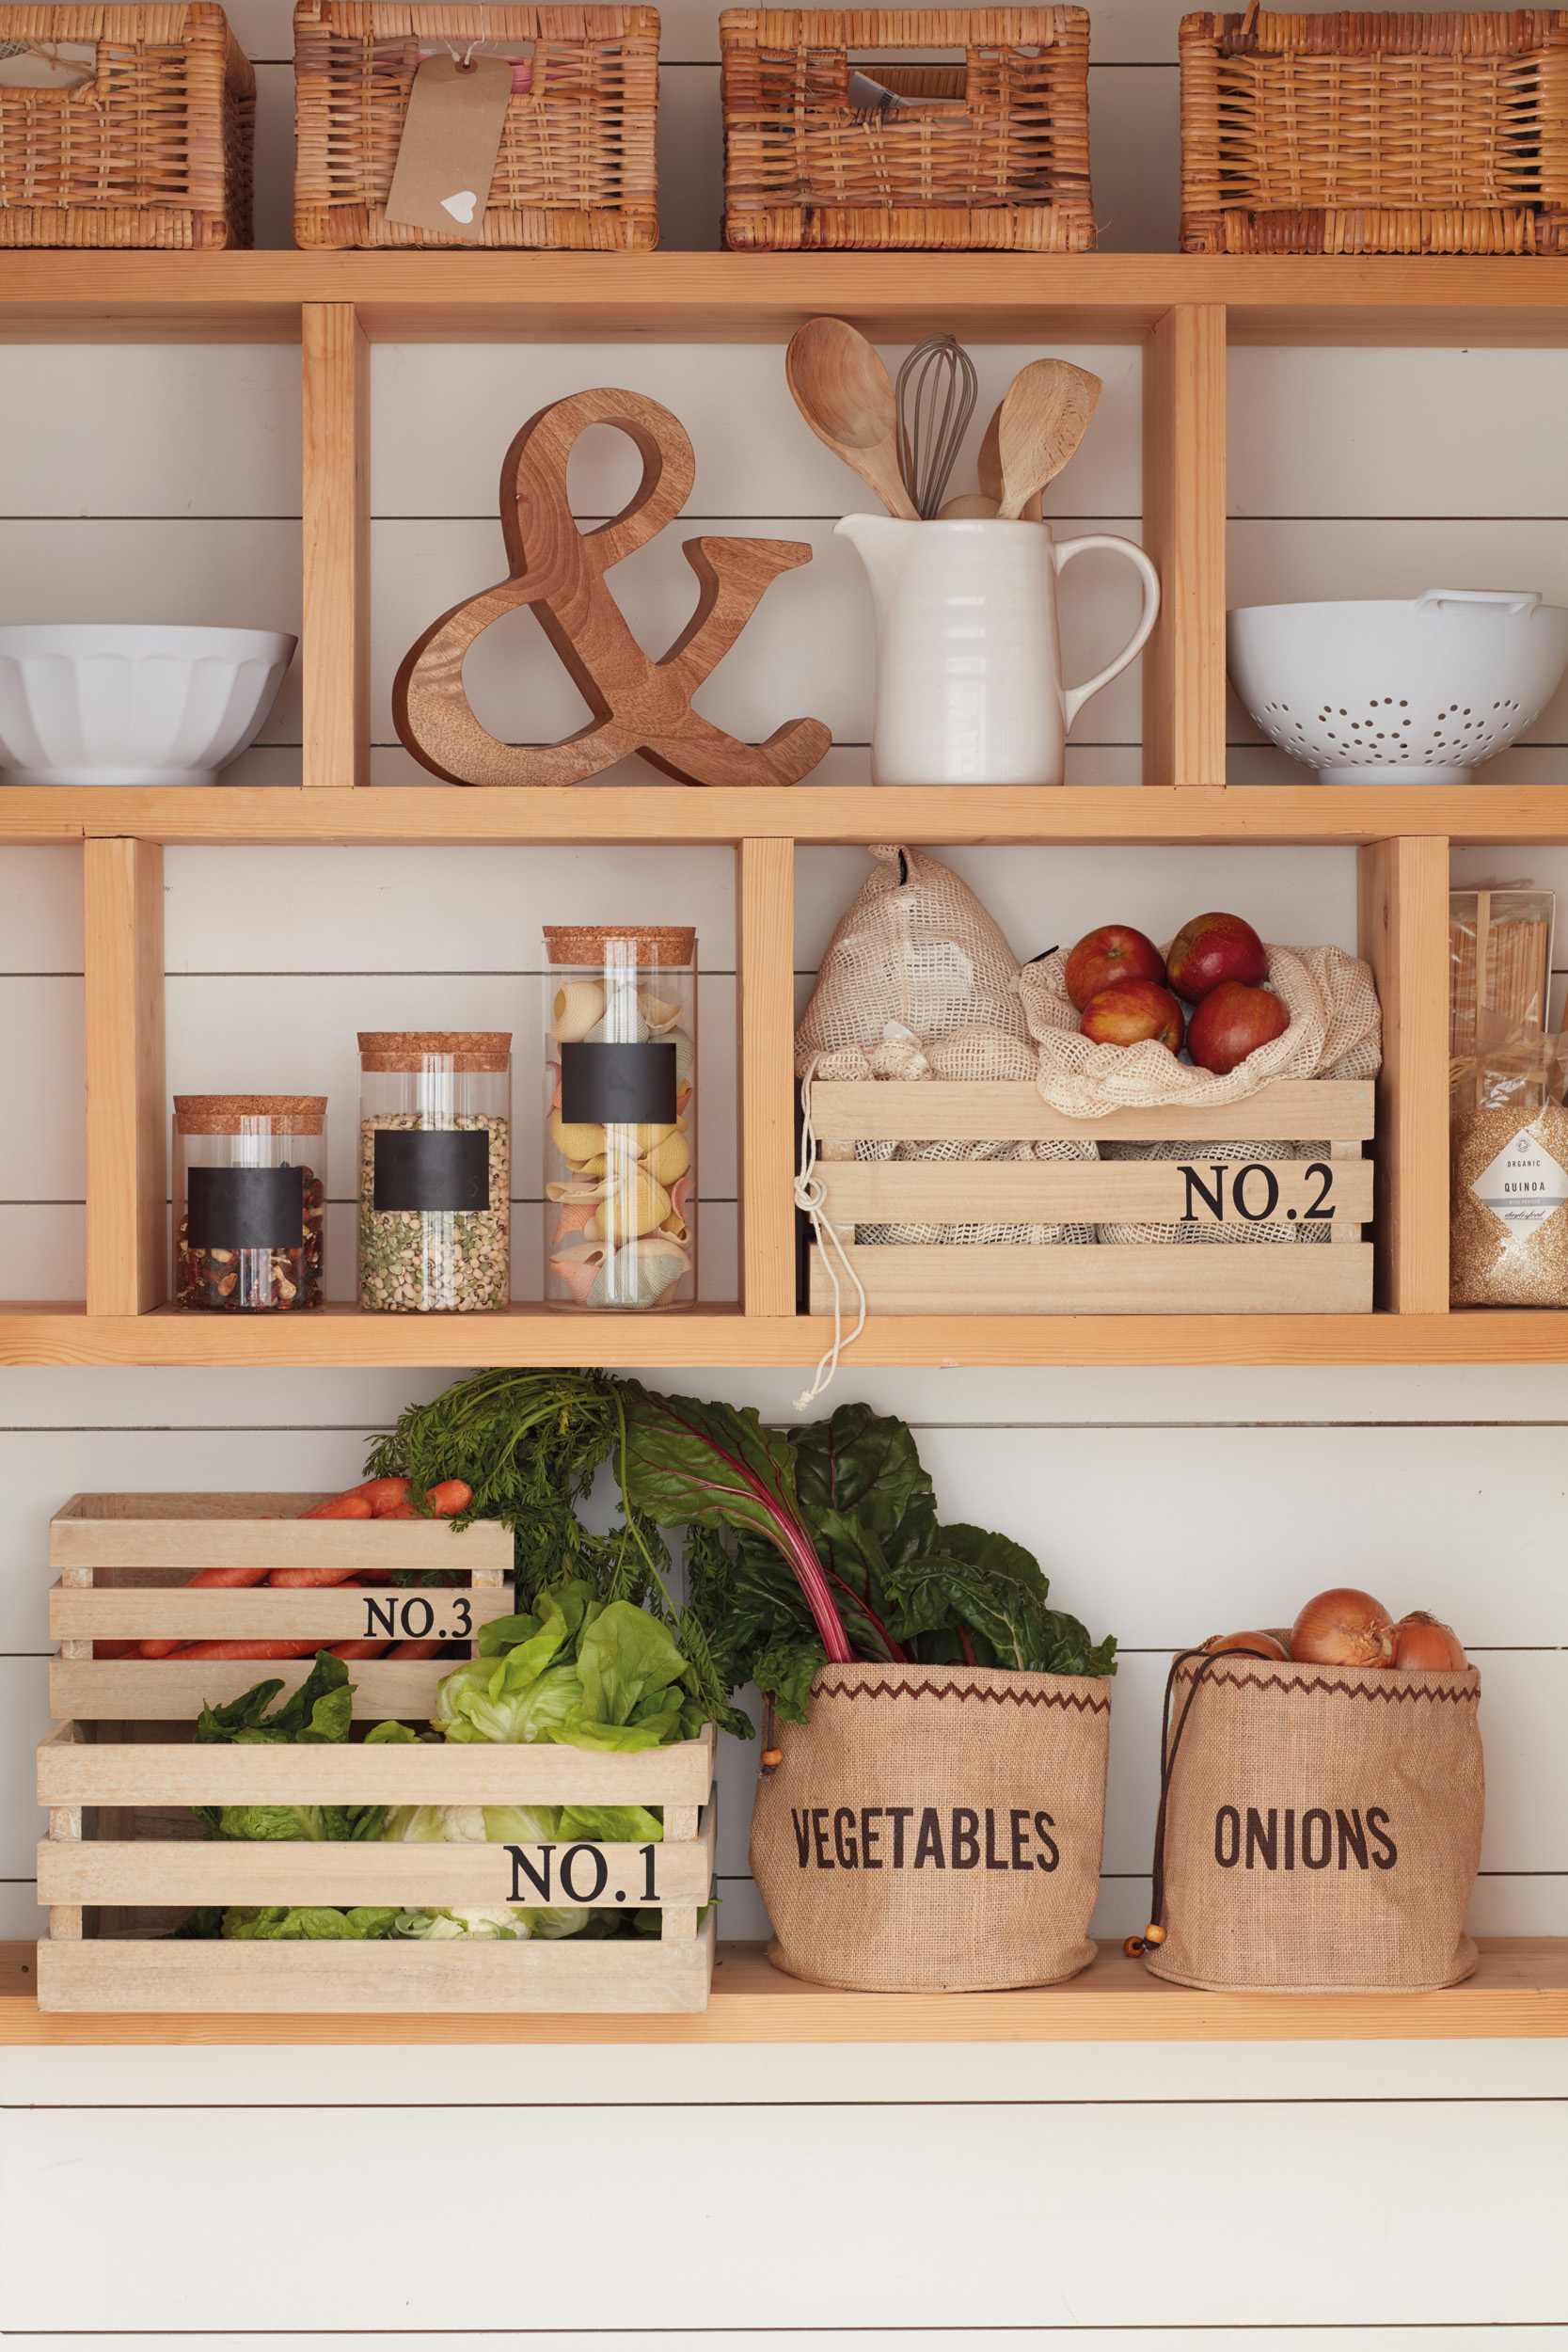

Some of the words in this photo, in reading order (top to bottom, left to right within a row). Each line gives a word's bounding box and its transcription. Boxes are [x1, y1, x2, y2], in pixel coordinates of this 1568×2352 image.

[393, 388, 831, 786] &
[1178, 1163, 1336, 1221] NO.2
[1504, 1182, 1545, 1192] QUINOA
[363, 1597, 471, 1638] NO.3
[791, 1807, 1059, 1872] VEGETABLES
[1215, 1805, 1397, 1870] ONIONS
[504, 1845, 659, 1901] NO.1
